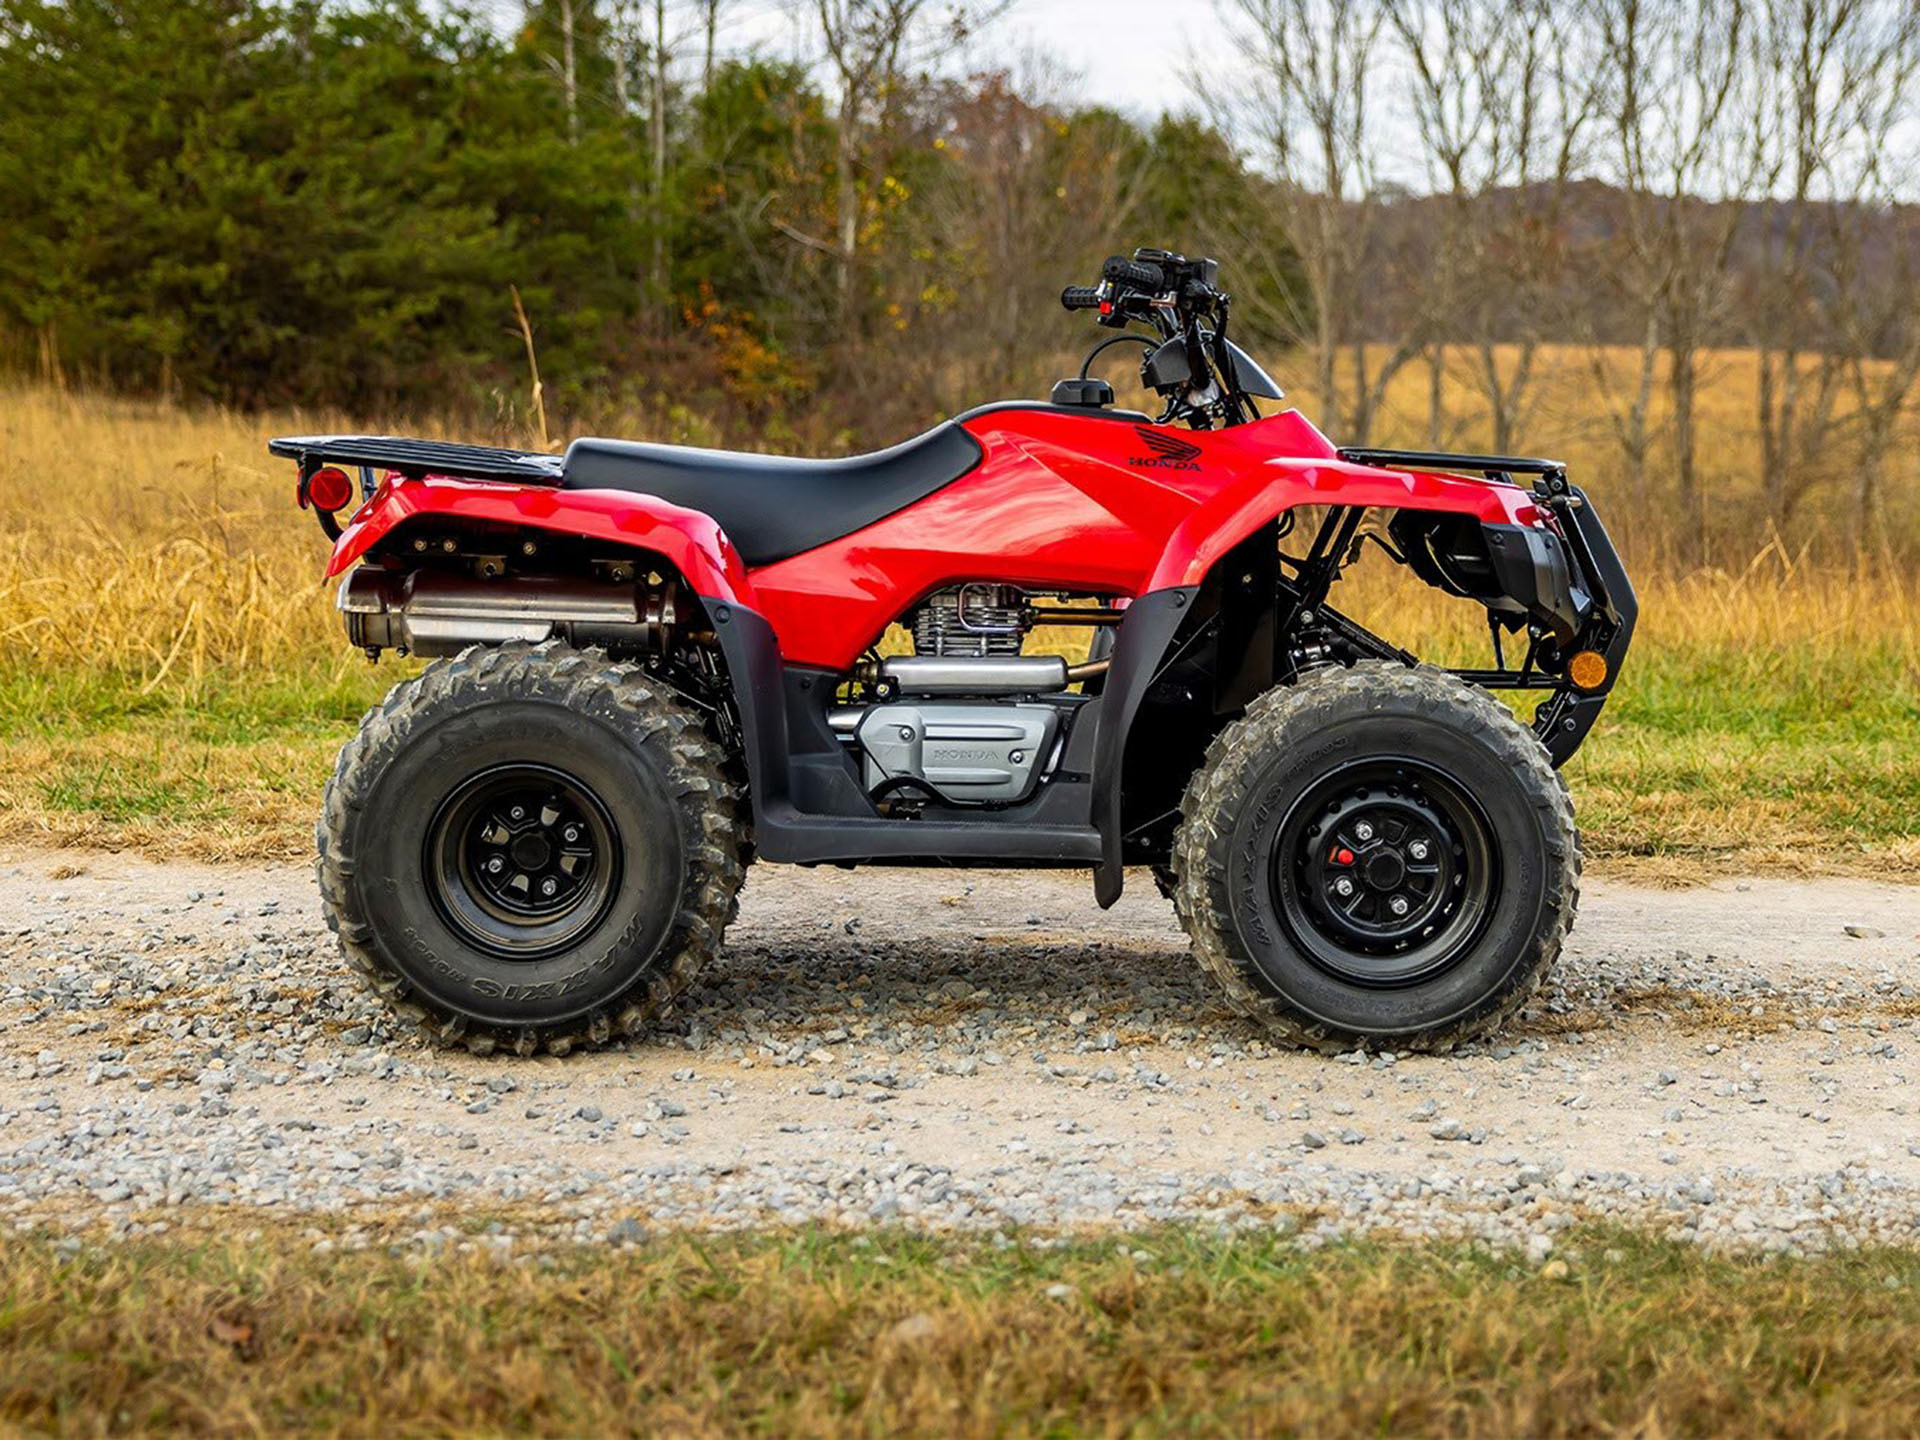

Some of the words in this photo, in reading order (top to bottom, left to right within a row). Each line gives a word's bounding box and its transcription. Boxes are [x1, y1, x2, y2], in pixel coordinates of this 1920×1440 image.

[1128, 457, 1203, 472] HONDA
[933, 749, 1000, 761] HONDA
[471, 911, 643, 1001] MAXXIS
